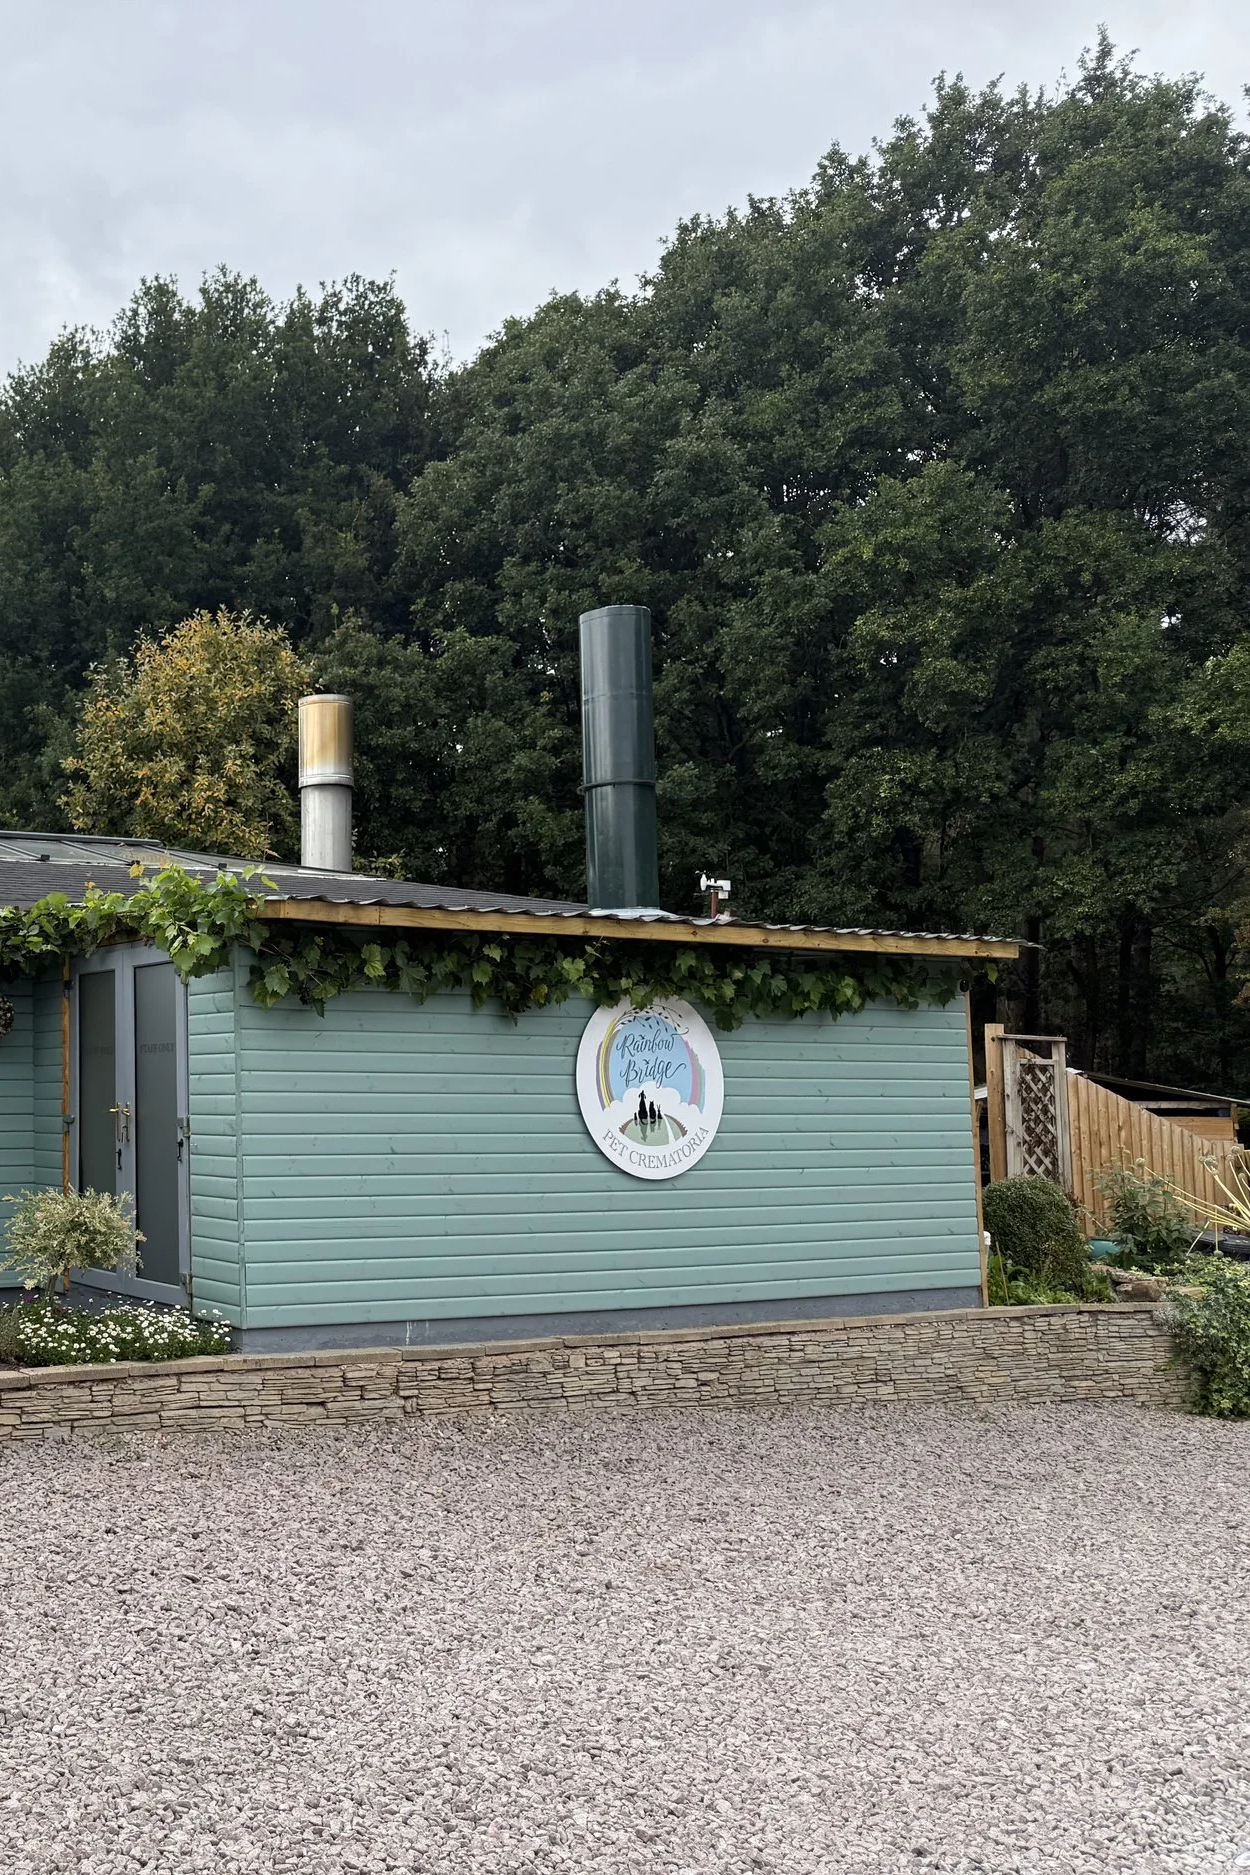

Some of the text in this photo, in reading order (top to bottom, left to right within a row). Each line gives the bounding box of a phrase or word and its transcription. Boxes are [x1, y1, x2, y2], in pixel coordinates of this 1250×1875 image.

[616, 1029, 689, 1058] Rainbow
[620, 1057, 686, 1088] Bridge
[602, 1127, 710, 1169] PET CREMATORIA
